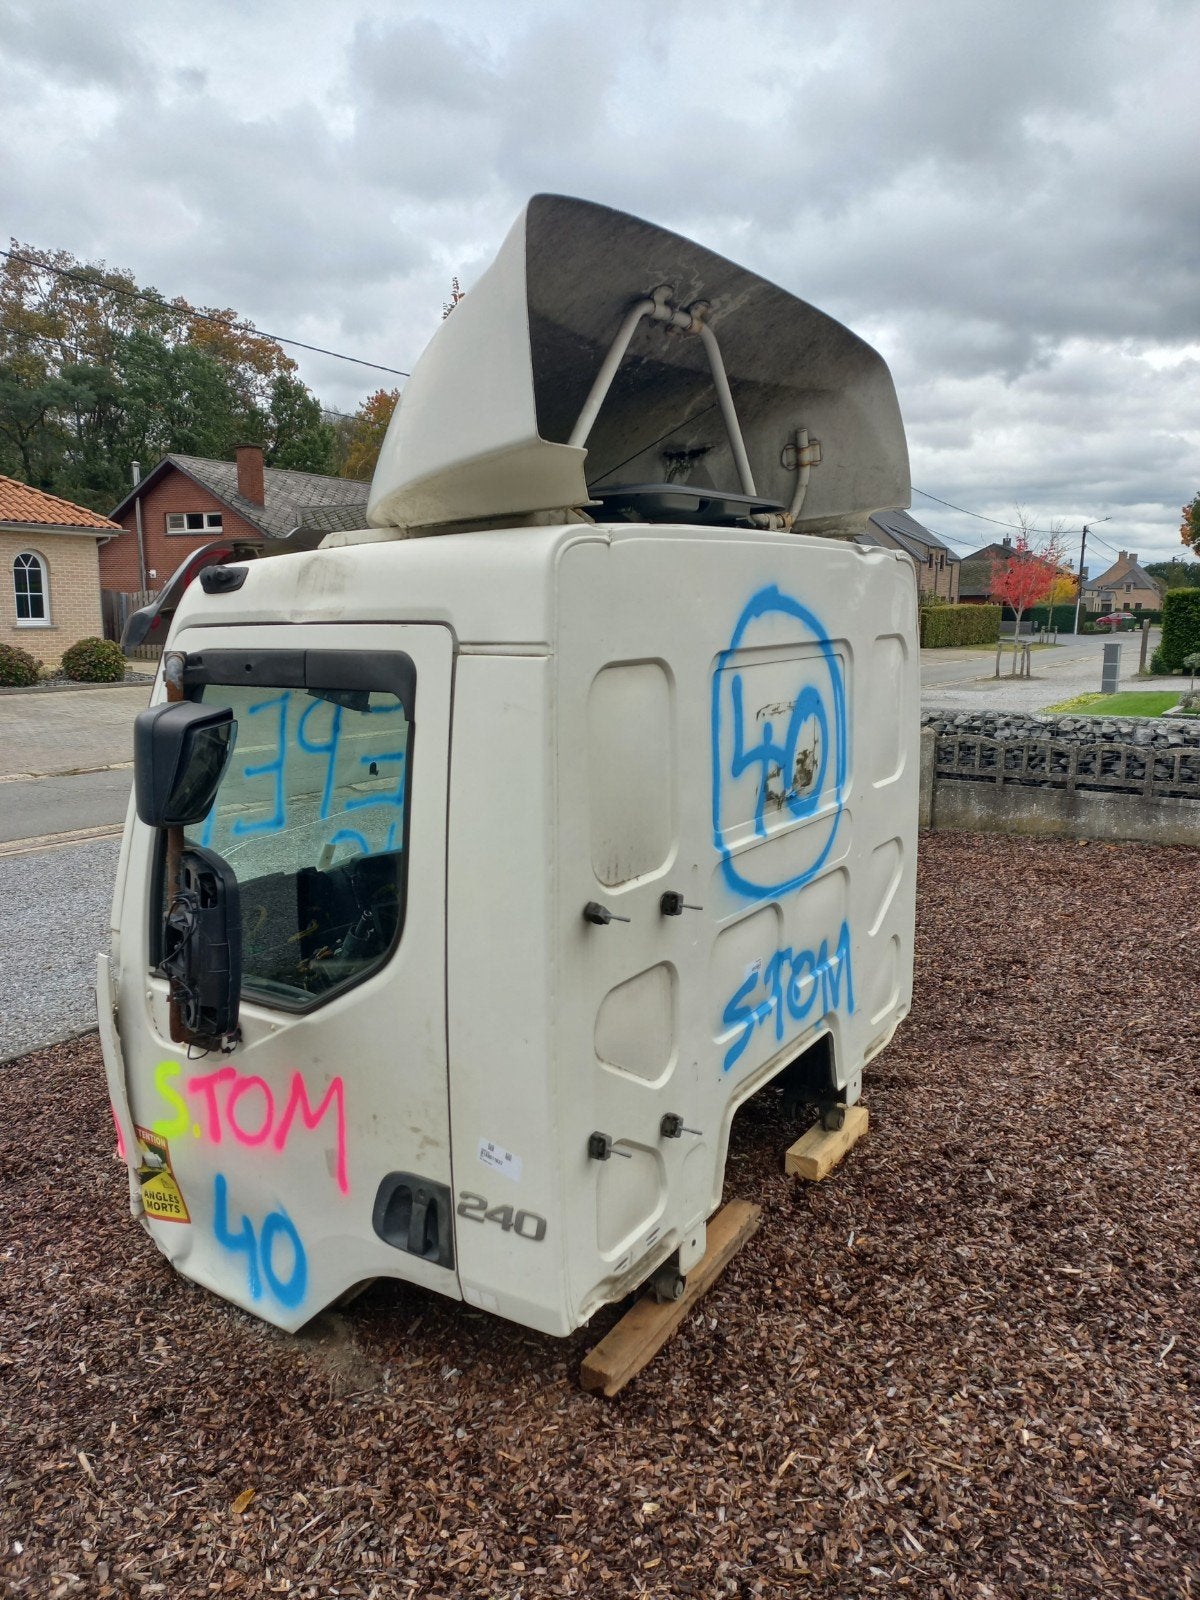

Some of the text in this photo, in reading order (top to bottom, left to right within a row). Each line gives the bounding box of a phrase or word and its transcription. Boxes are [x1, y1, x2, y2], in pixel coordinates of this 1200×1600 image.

[730, 673, 829, 838] 40
[136, 1128, 166, 1147] TENTION
[144, 1190, 180, 1204] ANGLES
[146, 1200, 181, 1213] MORTS
[457, 1190, 547, 1242] 240
[212, 1172, 308, 1308] 40
